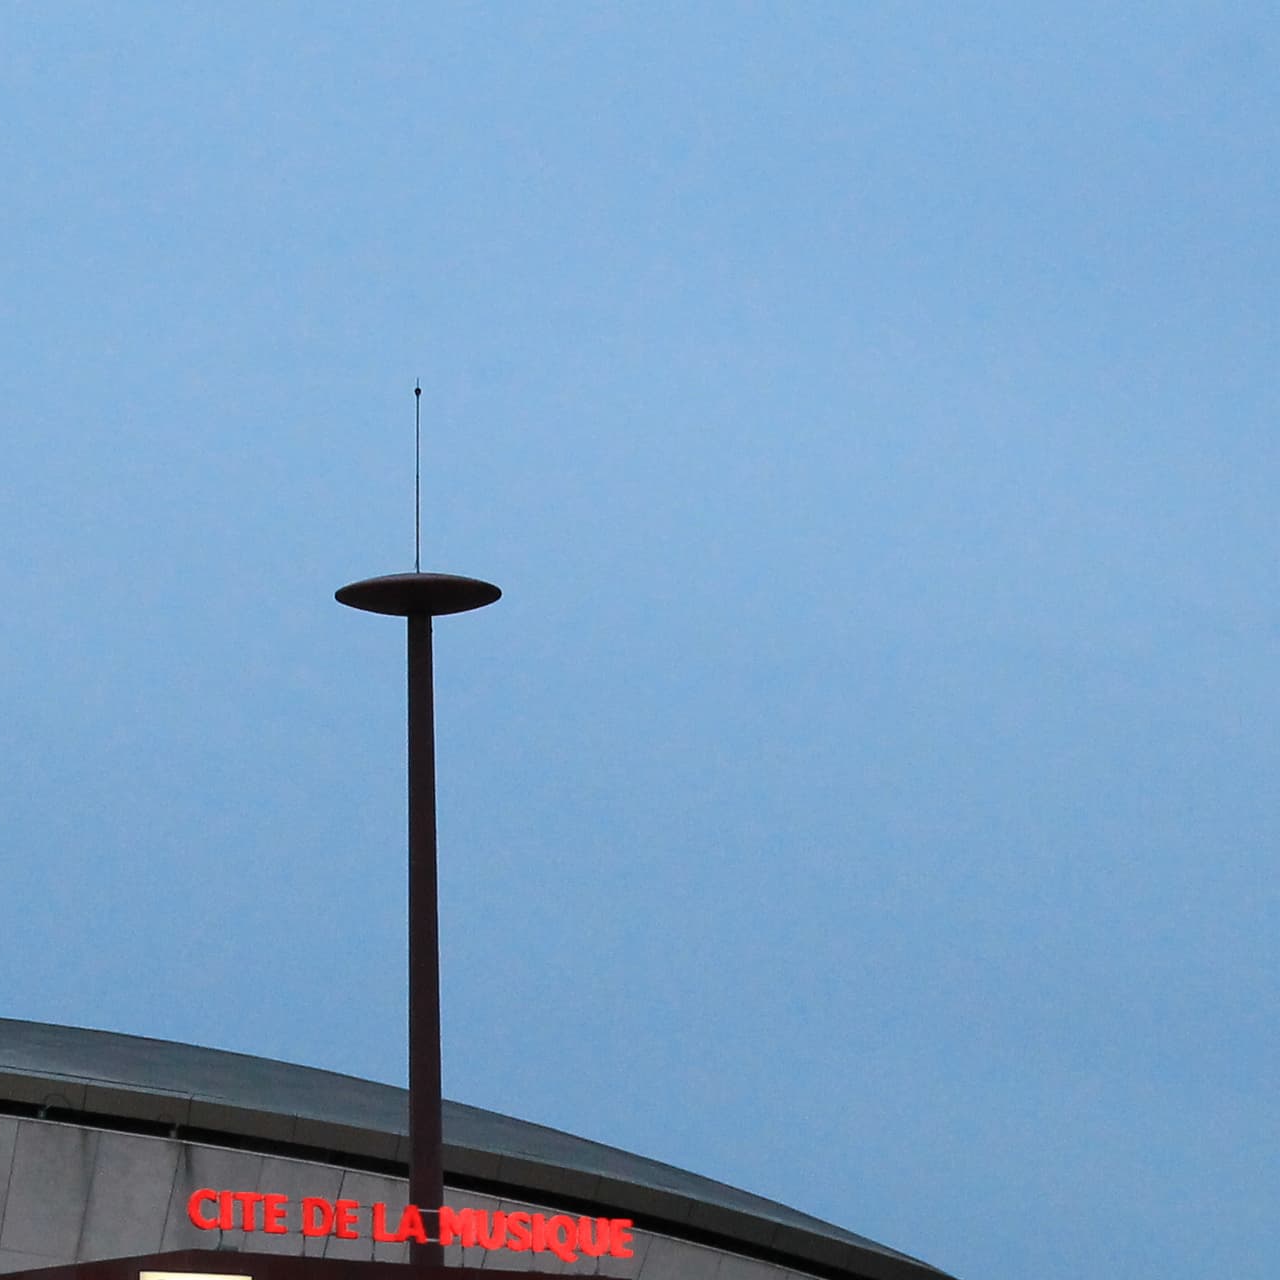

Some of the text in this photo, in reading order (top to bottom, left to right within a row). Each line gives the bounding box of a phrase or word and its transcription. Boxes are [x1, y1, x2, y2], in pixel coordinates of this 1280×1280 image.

[187, 1188, 634, 1264] CITE DE LA MUSIQUE
